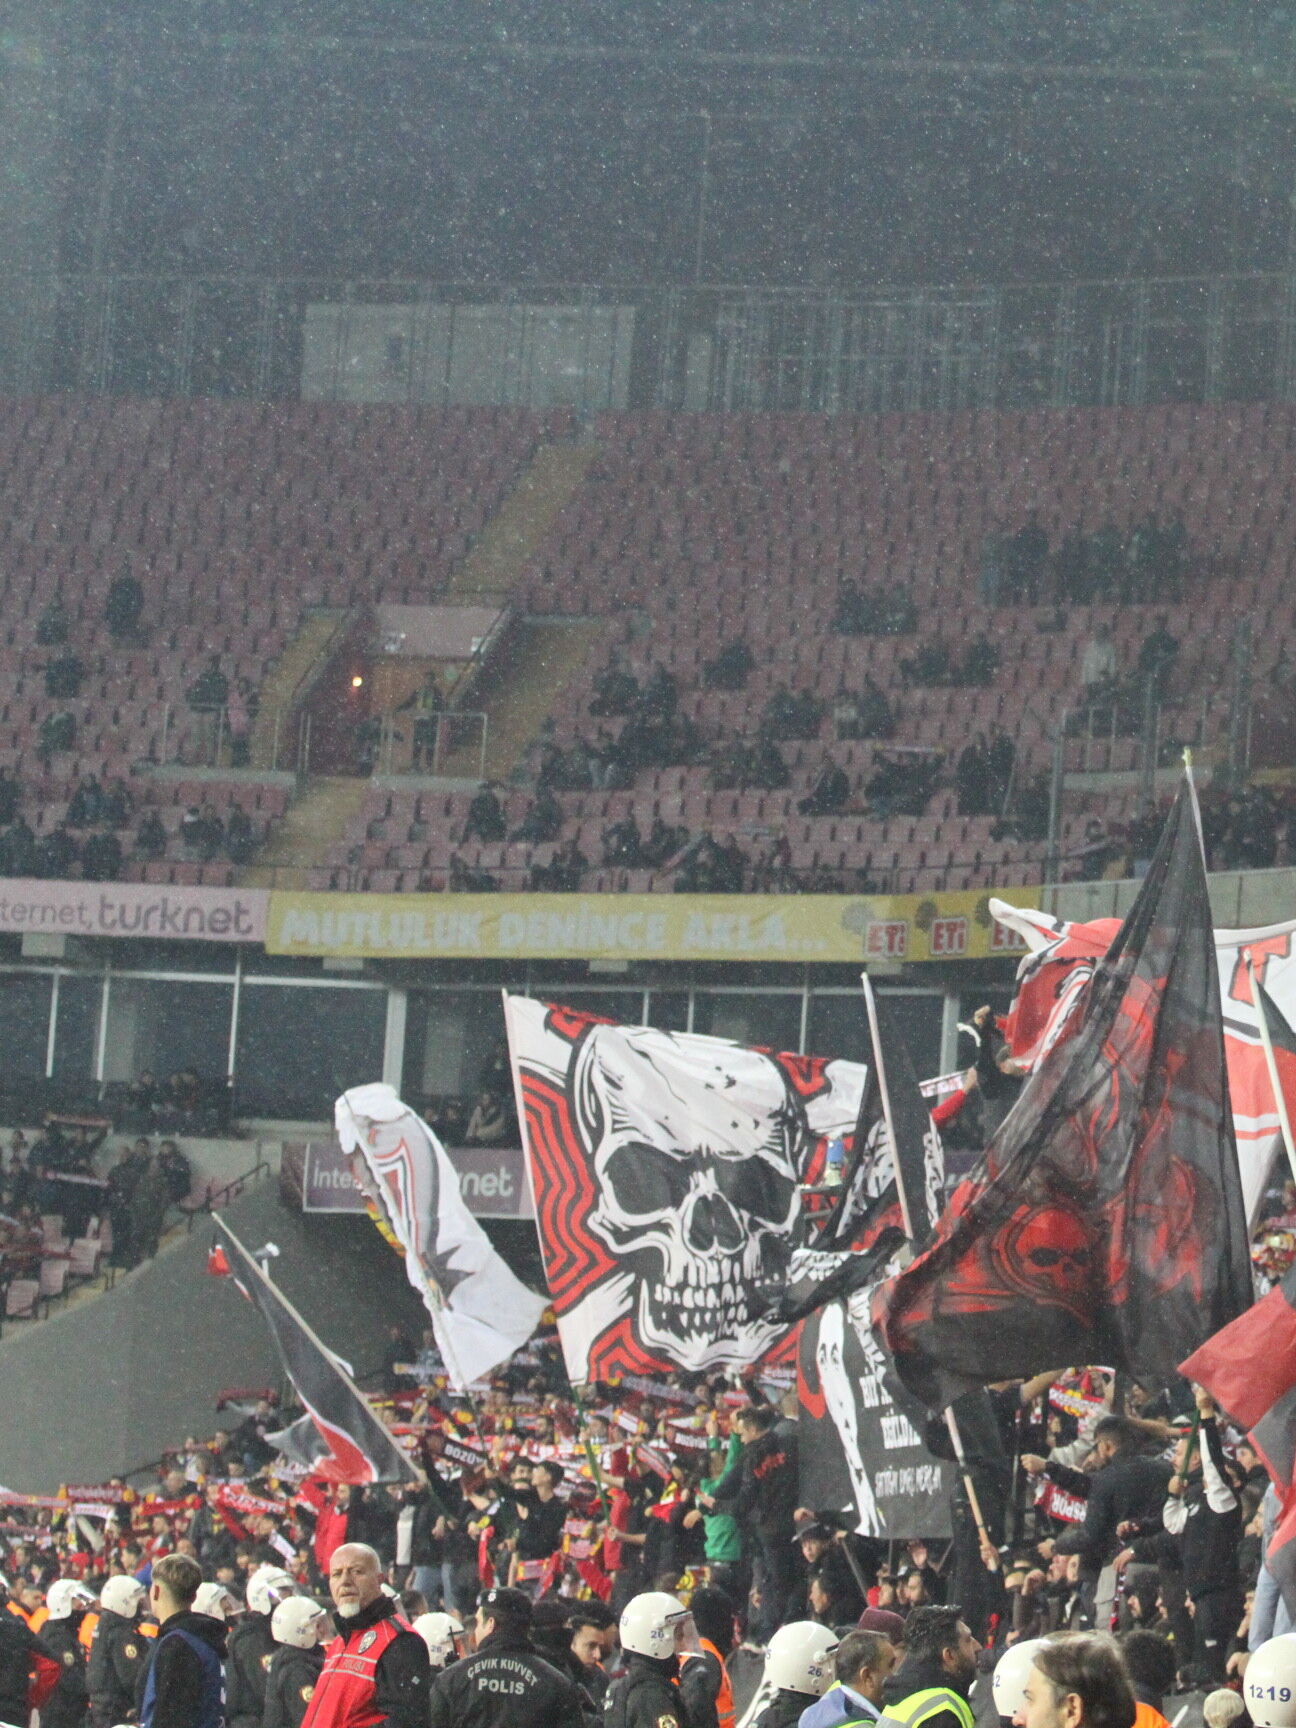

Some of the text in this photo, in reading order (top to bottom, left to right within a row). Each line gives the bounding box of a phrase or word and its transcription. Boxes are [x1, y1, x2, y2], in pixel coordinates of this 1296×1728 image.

[99, 895, 254, 934] turknet
[279, 908, 483, 948] MUTLULUK
[500, 1659, 539, 1687] KUVVET
[808, 1665, 823, 1677] 26
